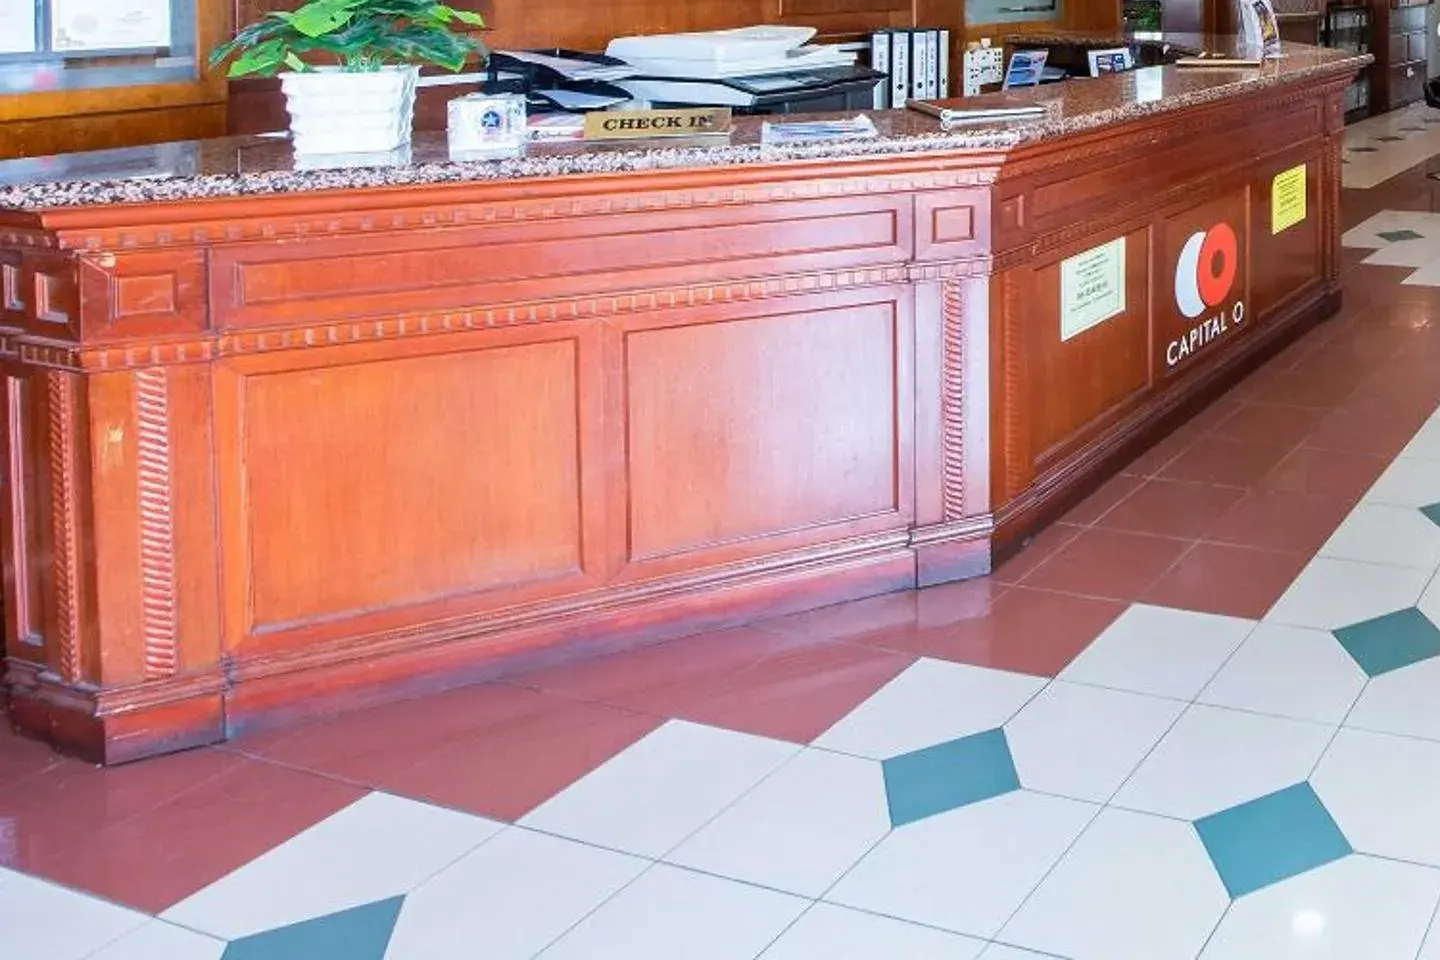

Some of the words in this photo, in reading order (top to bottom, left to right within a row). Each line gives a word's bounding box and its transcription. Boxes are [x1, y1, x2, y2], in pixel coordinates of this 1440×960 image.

[602, 116, 682, 131] CHECK
[687, 115, 713, 127] IN
[1166, 311, 1228, 366] CAPITAL
[1232, 301, 1244, 323] O
